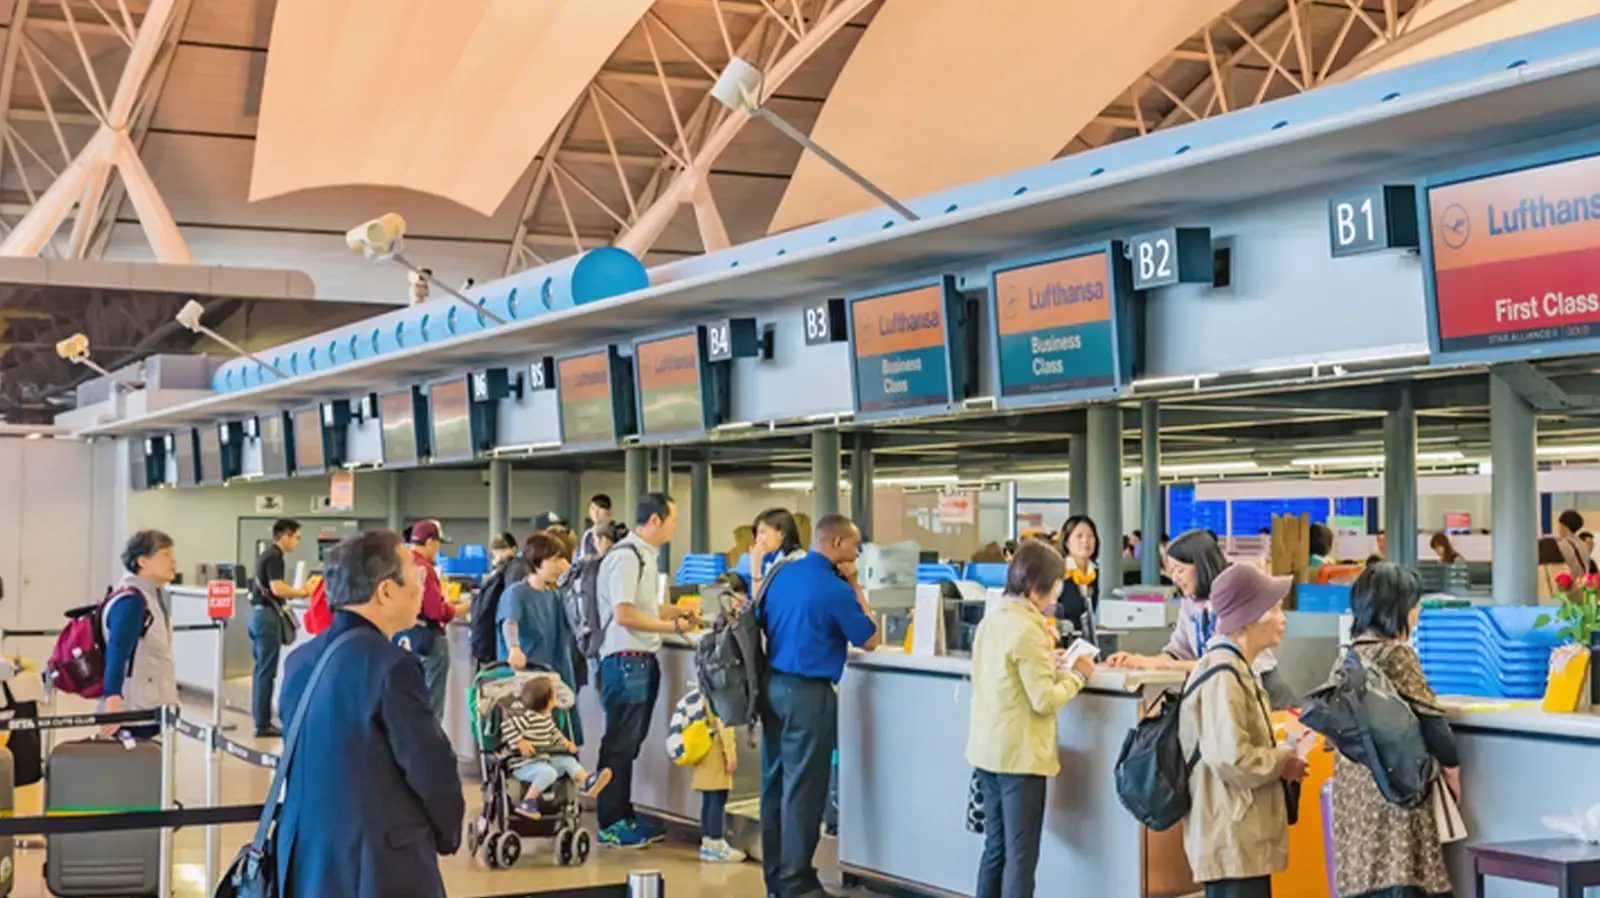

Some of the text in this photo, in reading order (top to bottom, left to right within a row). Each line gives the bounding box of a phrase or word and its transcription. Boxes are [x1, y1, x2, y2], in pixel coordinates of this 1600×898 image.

[1337, 198, 1375, 245] B1
[1139, 239, 1171, 280] B2
[1028, 280, 1104, 311] Lufthansa
[1495, 291, 1599, 322] First Class
[806, 307, 827, 340] B3
[879, 310, 940, 336] Lufthansa
[711, 325, 729, 356] B4
[1031, 333, 1081, 355] Business
[1032, 357, 1063, 376] Class
